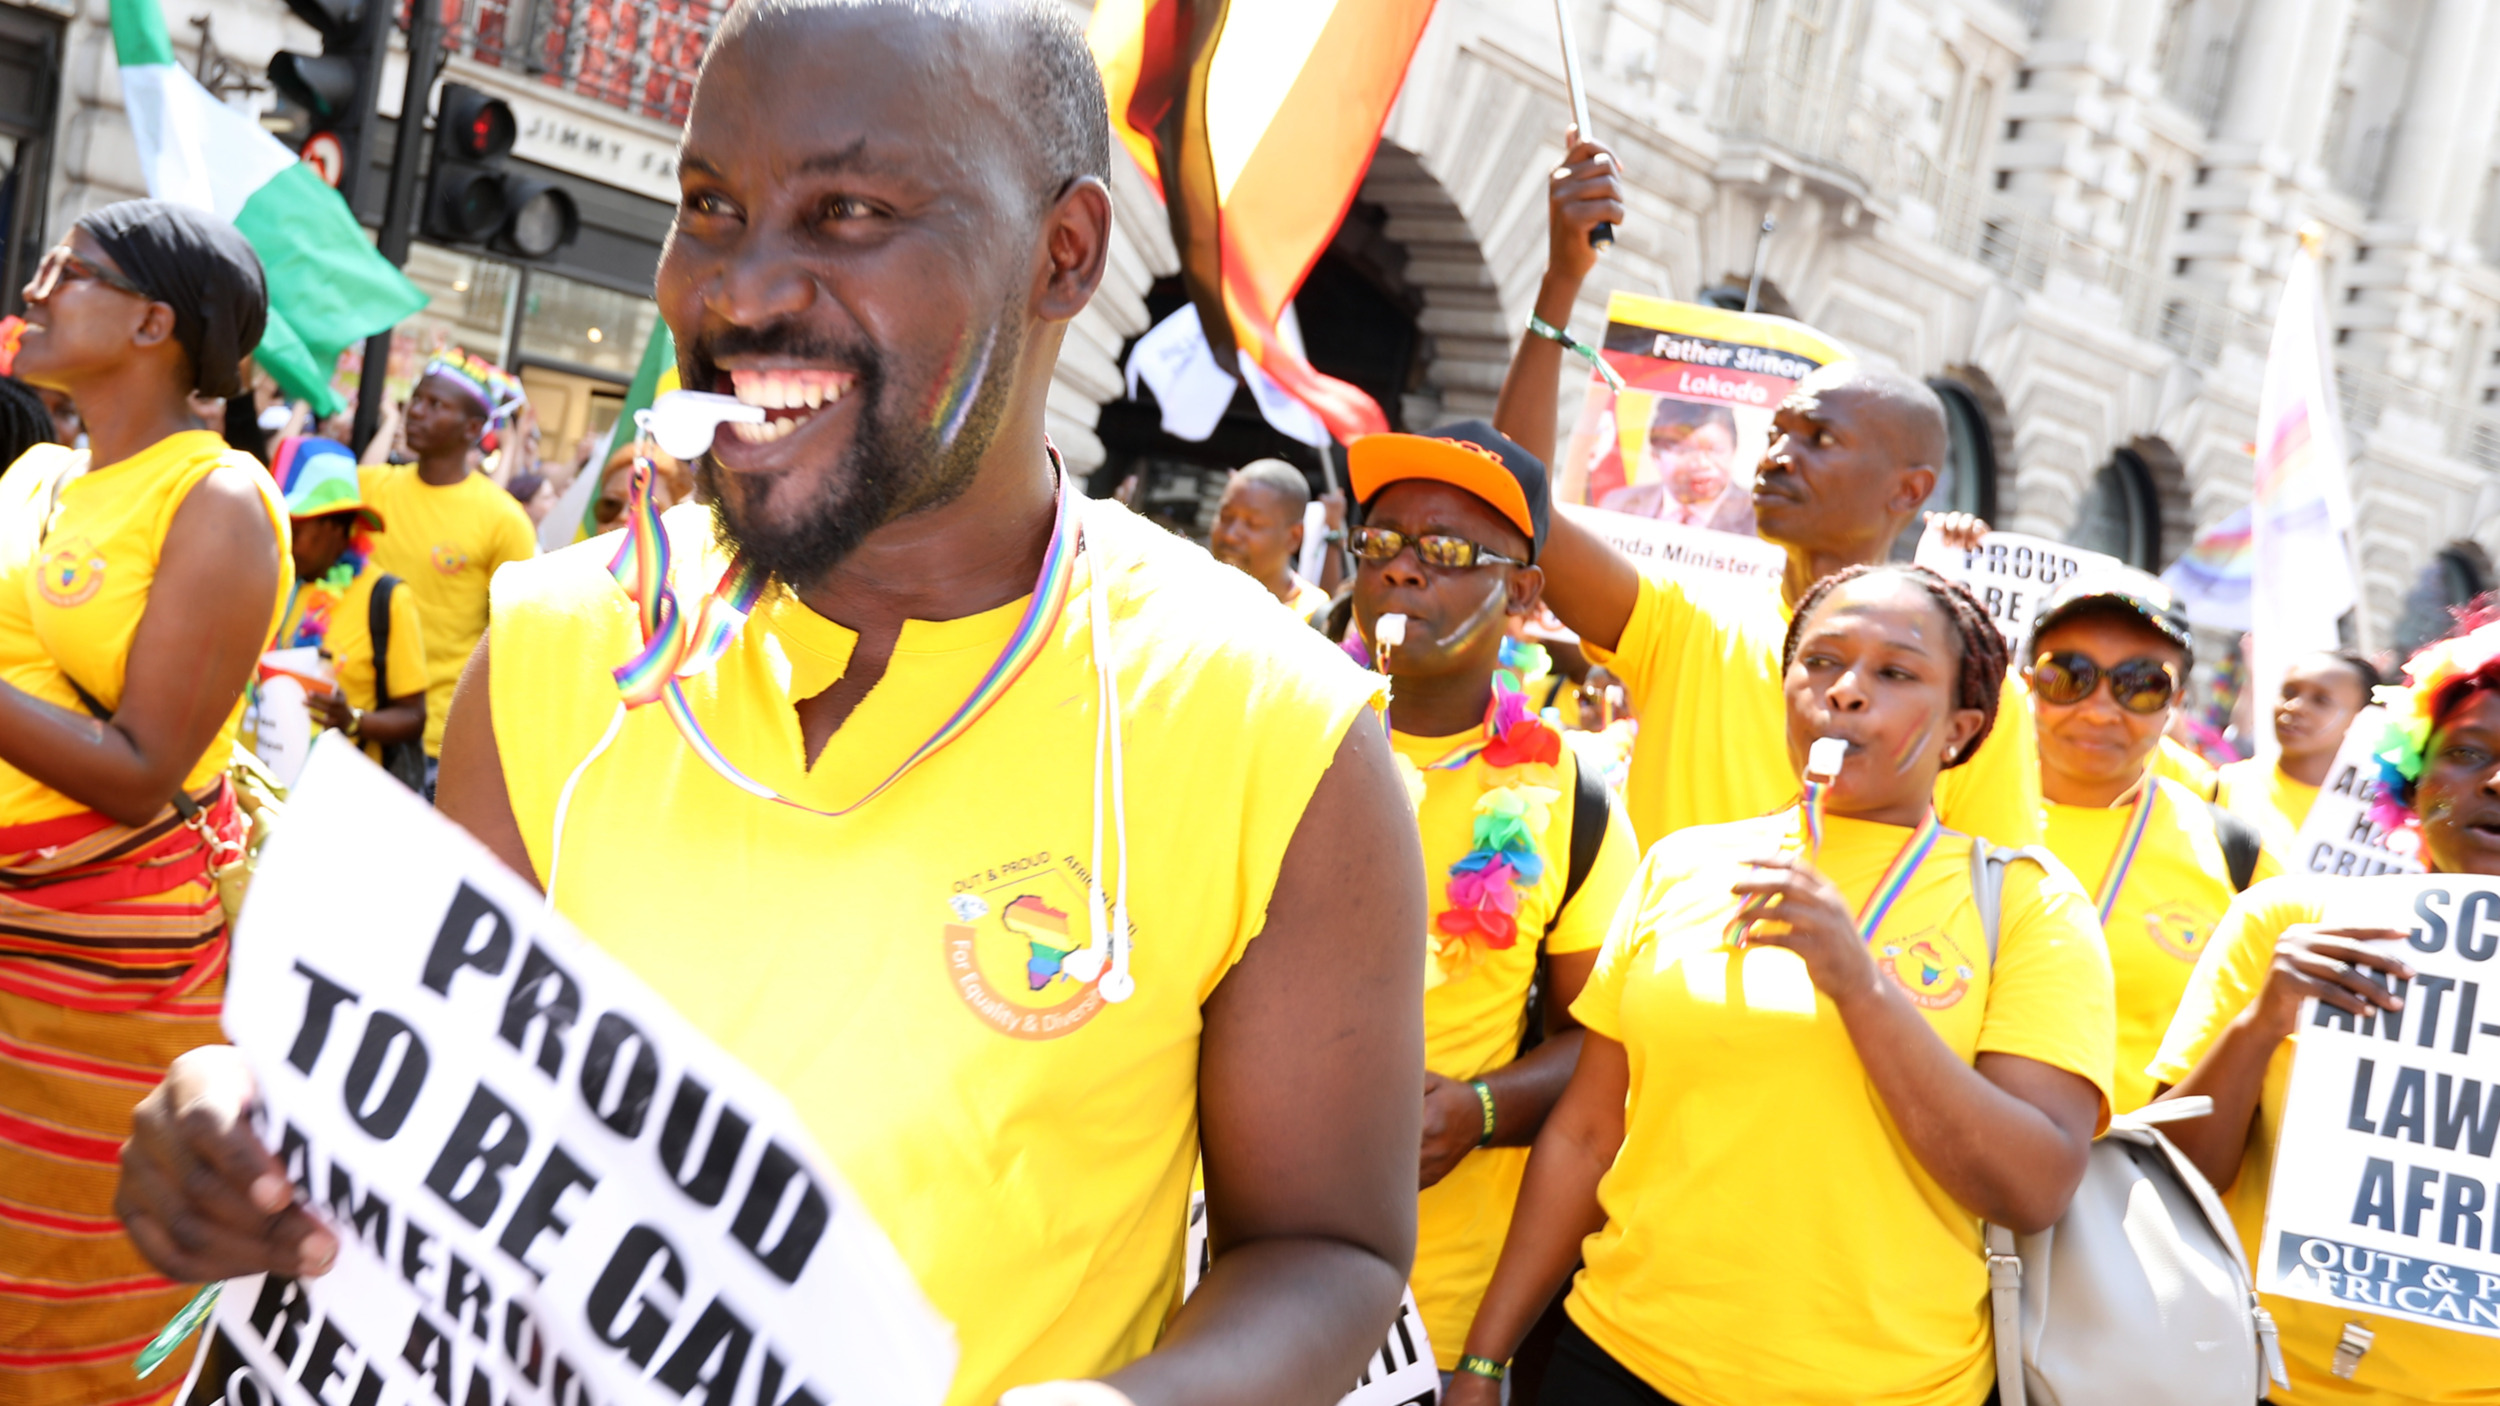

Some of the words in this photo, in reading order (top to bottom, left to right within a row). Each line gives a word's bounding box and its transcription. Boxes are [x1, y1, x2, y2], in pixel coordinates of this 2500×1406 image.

[525, 117, 625, 161] JIMMY
[1652, 334, 1731, 366] Father
[1736, 347, 1813, 379] Simon
[1678, 371, 1769, 404] Lokodo
[1604, 534, 1654, 557] nda
[1662, 542, 1760, 577] Minister
[1963, 543, 2078, 584] PROUD
[1984, 586, 2023, 623] BE
[953, 873, 982, 893] OUT
[988, 869, 998, 882] &
[1001, 851, 1051, 874] PROUD
[952, 939, 972, 970] For
[959, 972, 1021, 1032] Equality
[1022, 1014, 1038, 1033] &
[419, 878, 831, 1286] PROUD
[286, 958, 431, 1141] TO
[422, 1079, 602, 1283] BE
[2299, 1238, 2411, 1283] OUT
[2422, 1264, 2464, 1296] &
